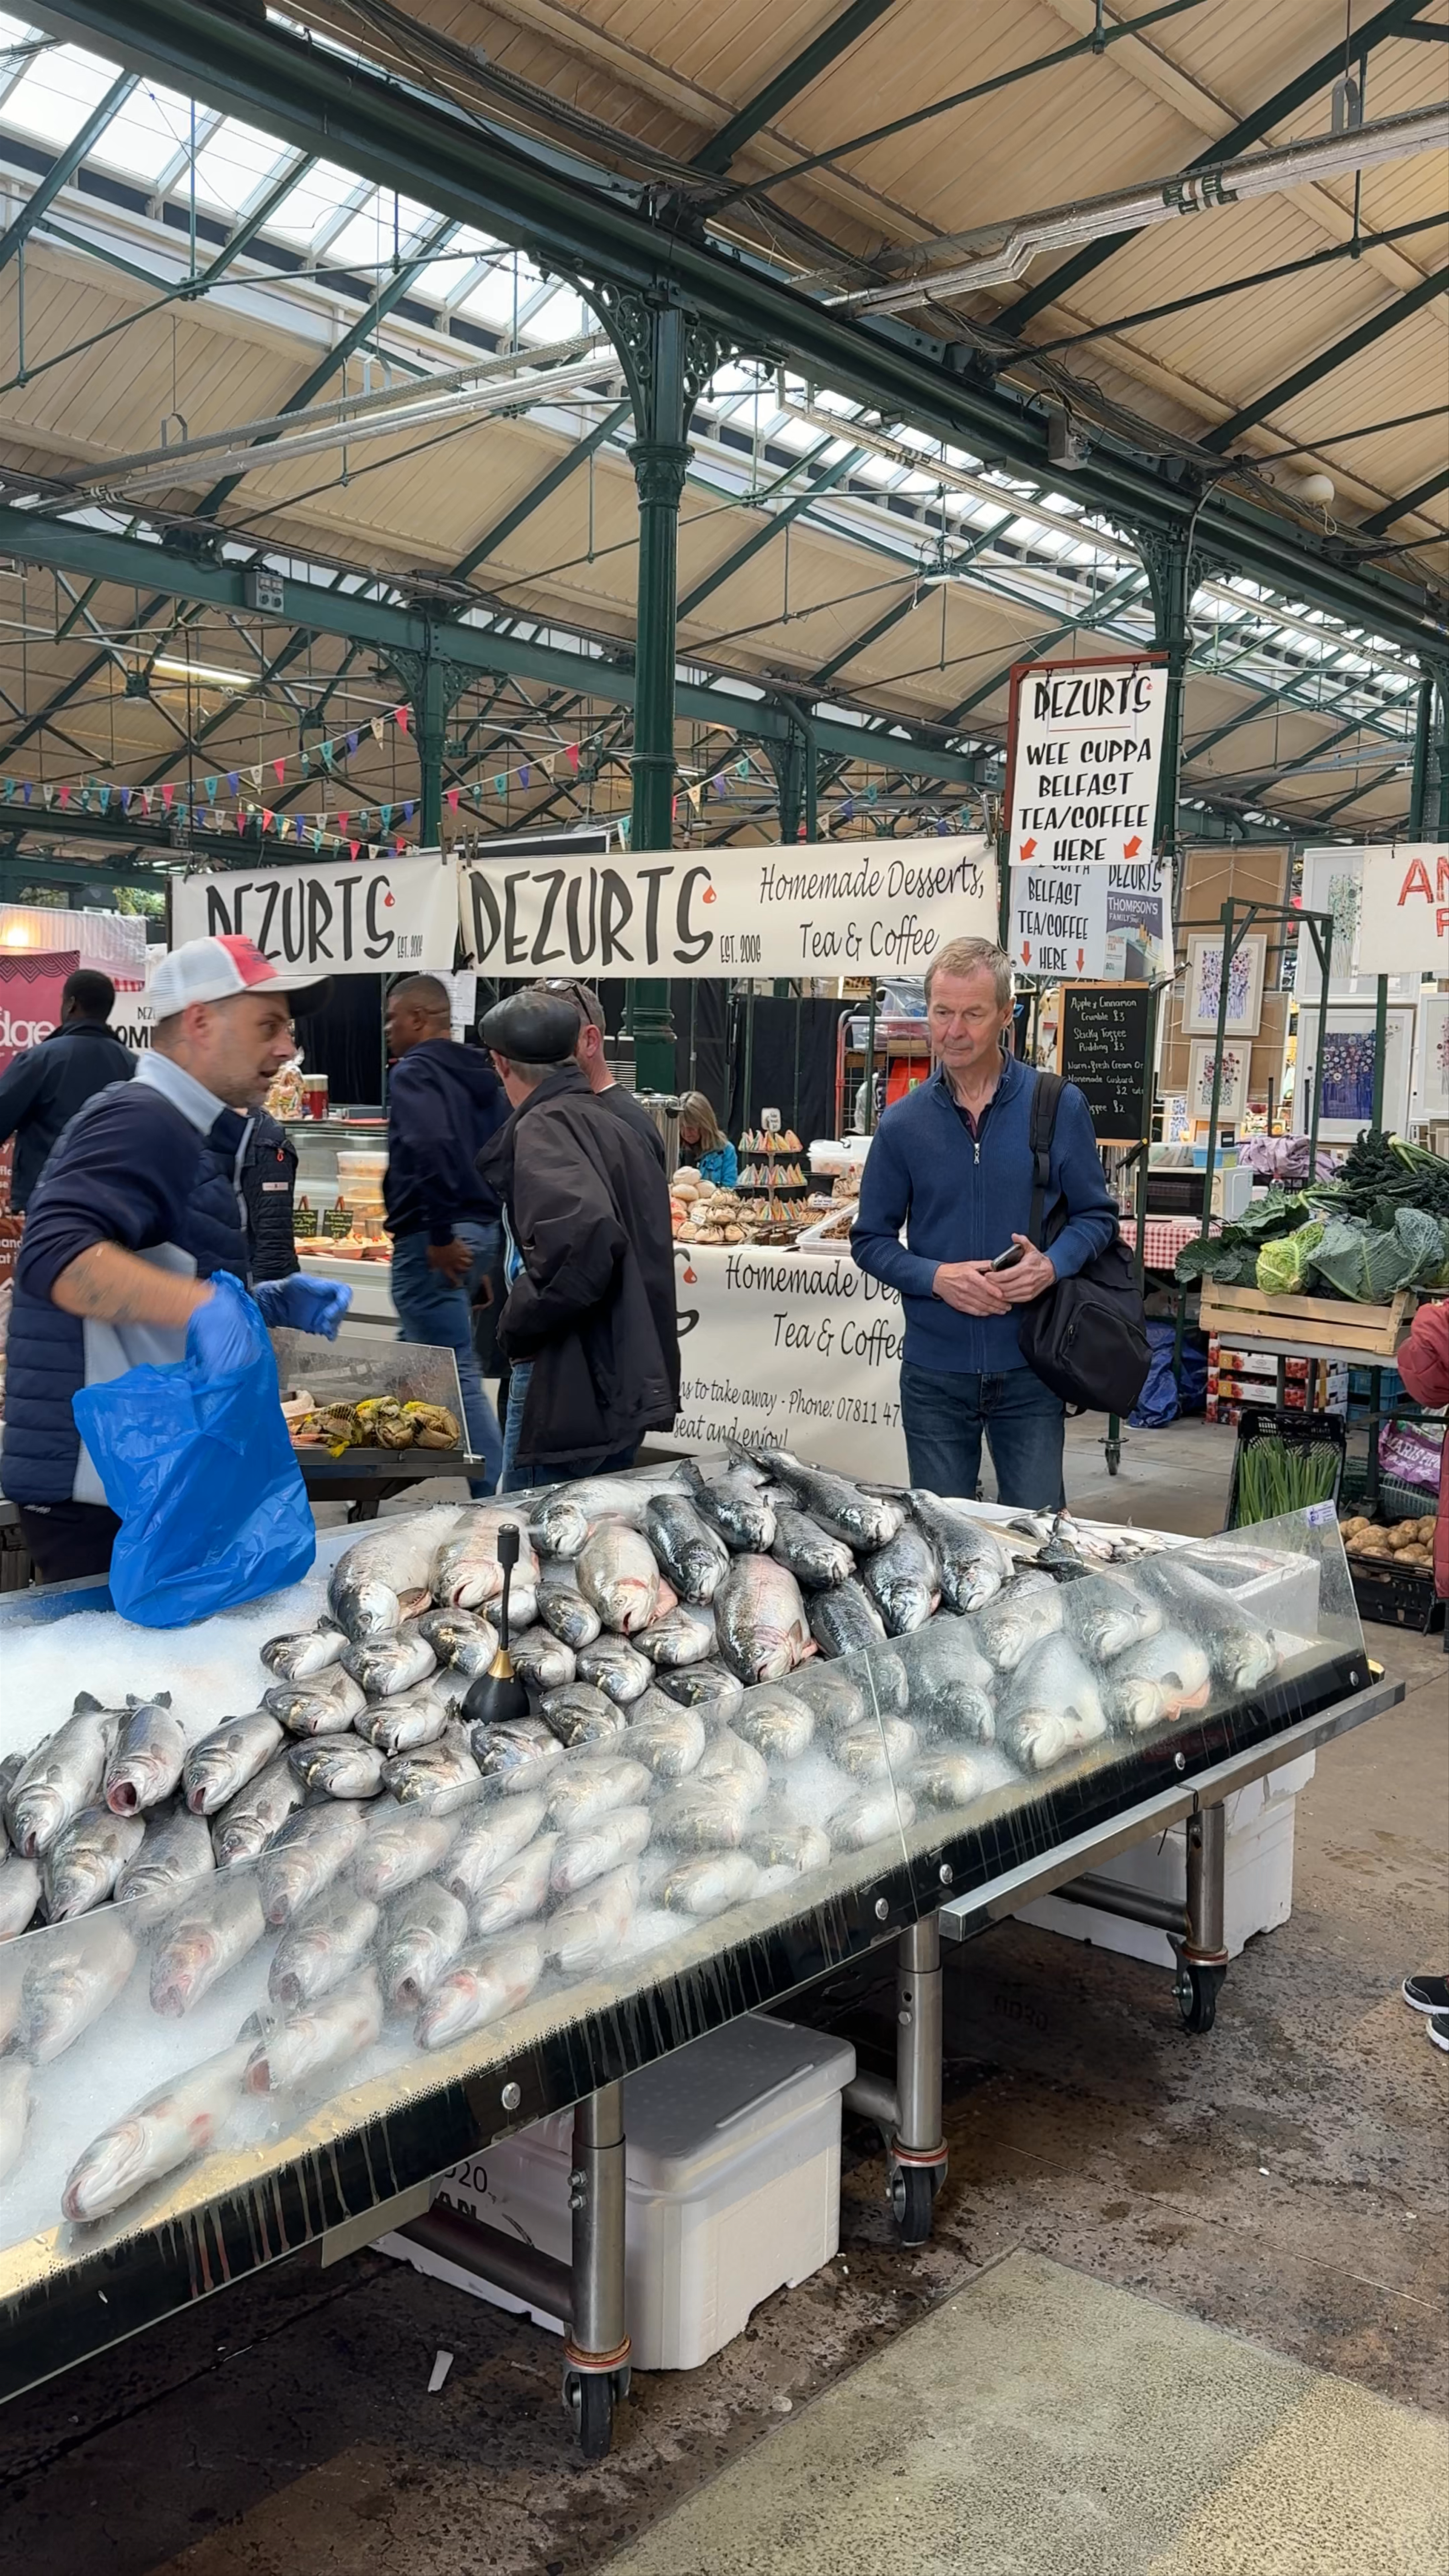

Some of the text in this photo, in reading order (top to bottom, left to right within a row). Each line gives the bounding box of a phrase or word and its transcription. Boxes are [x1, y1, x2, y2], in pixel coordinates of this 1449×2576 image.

[1034, 676, 1151, 720] DEZURTS
[1027, 738, 1151, 765] WEE CUPPA
[1039, 772, 1134, 798] BELFAST
[1019, 804, 1149, 830] TEA/COFFEE
[1053, 838, 1107, 861] HERE
[760, 856, 984, 903] Homemade Desserts,
[1028, 877, 1082, 906] BELFAST
[469, 866, 761, 966] DEZURTS EST. 2006
[1108, 897, 1158, 915] THOMPSON'S
[1109, 913, 1130, 922] FAMILY
[1018, 910, 1089, 940] TEA/COFFEE
[398, 936, 409, 958] EST.
[800, 915, 940, 965] Tea & Coffee
[1039, 946, 1067, 971] HERE
[1071, 996, 1091, 1011] Apple
[1099, 996, 1137, 1007] Cinnamon
[1081, 1010, 1125, 1021] Crumble £3
[1079, 1041, 1124, 1053] Pudding £3
[1101, 1027, 1127, 1042] Toffee
[725, 1253, 858, 1297] Homemade
[774, 1311, 815, 1348] Tea
[818, 1319, 834, 1356] &
[695, 1378, 709, 1399] to
[711, 1379, 740, 1403] take
[742, 1390, 777, 1416] away
[789, 1389, 834, 1417] Phone:
[837, 1397, 877, 1424] 07811
[674, 1415, 706, 1439] seat
[707, 1417, 741, 1443] and
